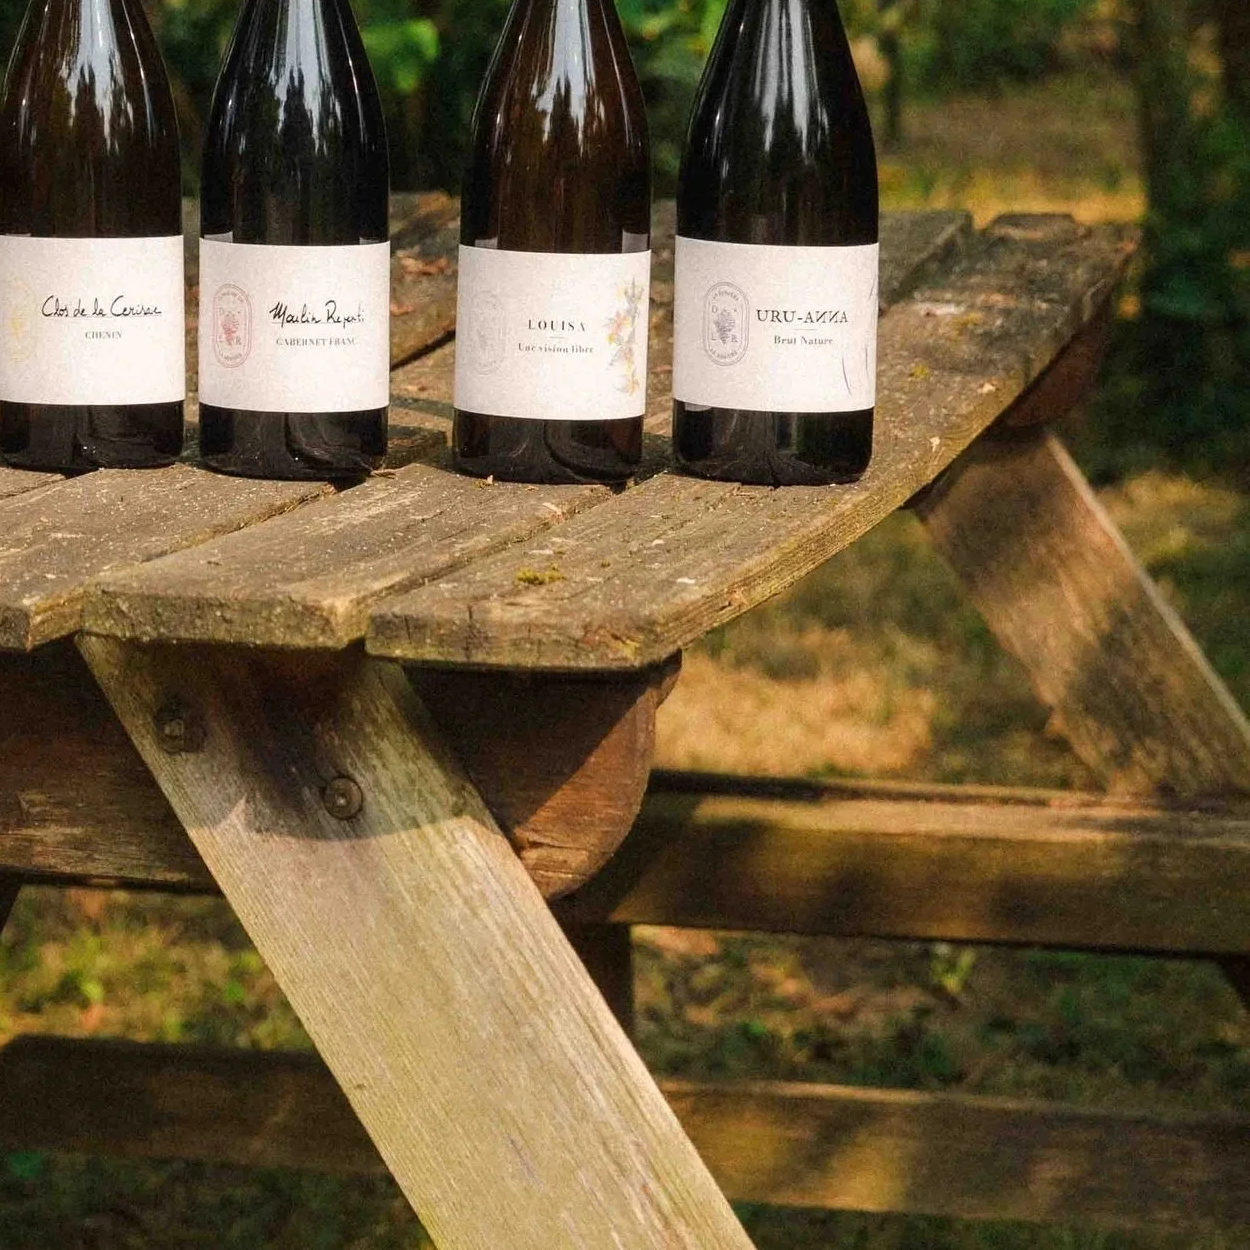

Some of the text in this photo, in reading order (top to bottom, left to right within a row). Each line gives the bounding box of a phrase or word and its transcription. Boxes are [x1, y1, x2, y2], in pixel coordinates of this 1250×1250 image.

[41, 295, 69, 317] Clos
[73, 298, 88, 317] de
[527, 319, 587, 332] LOUISA
[85, 331, 122, 340] CHENIN
[774, 335, 834, 346] Brut Nature
[276, 336, 358, 347] CABERNET FRANC
